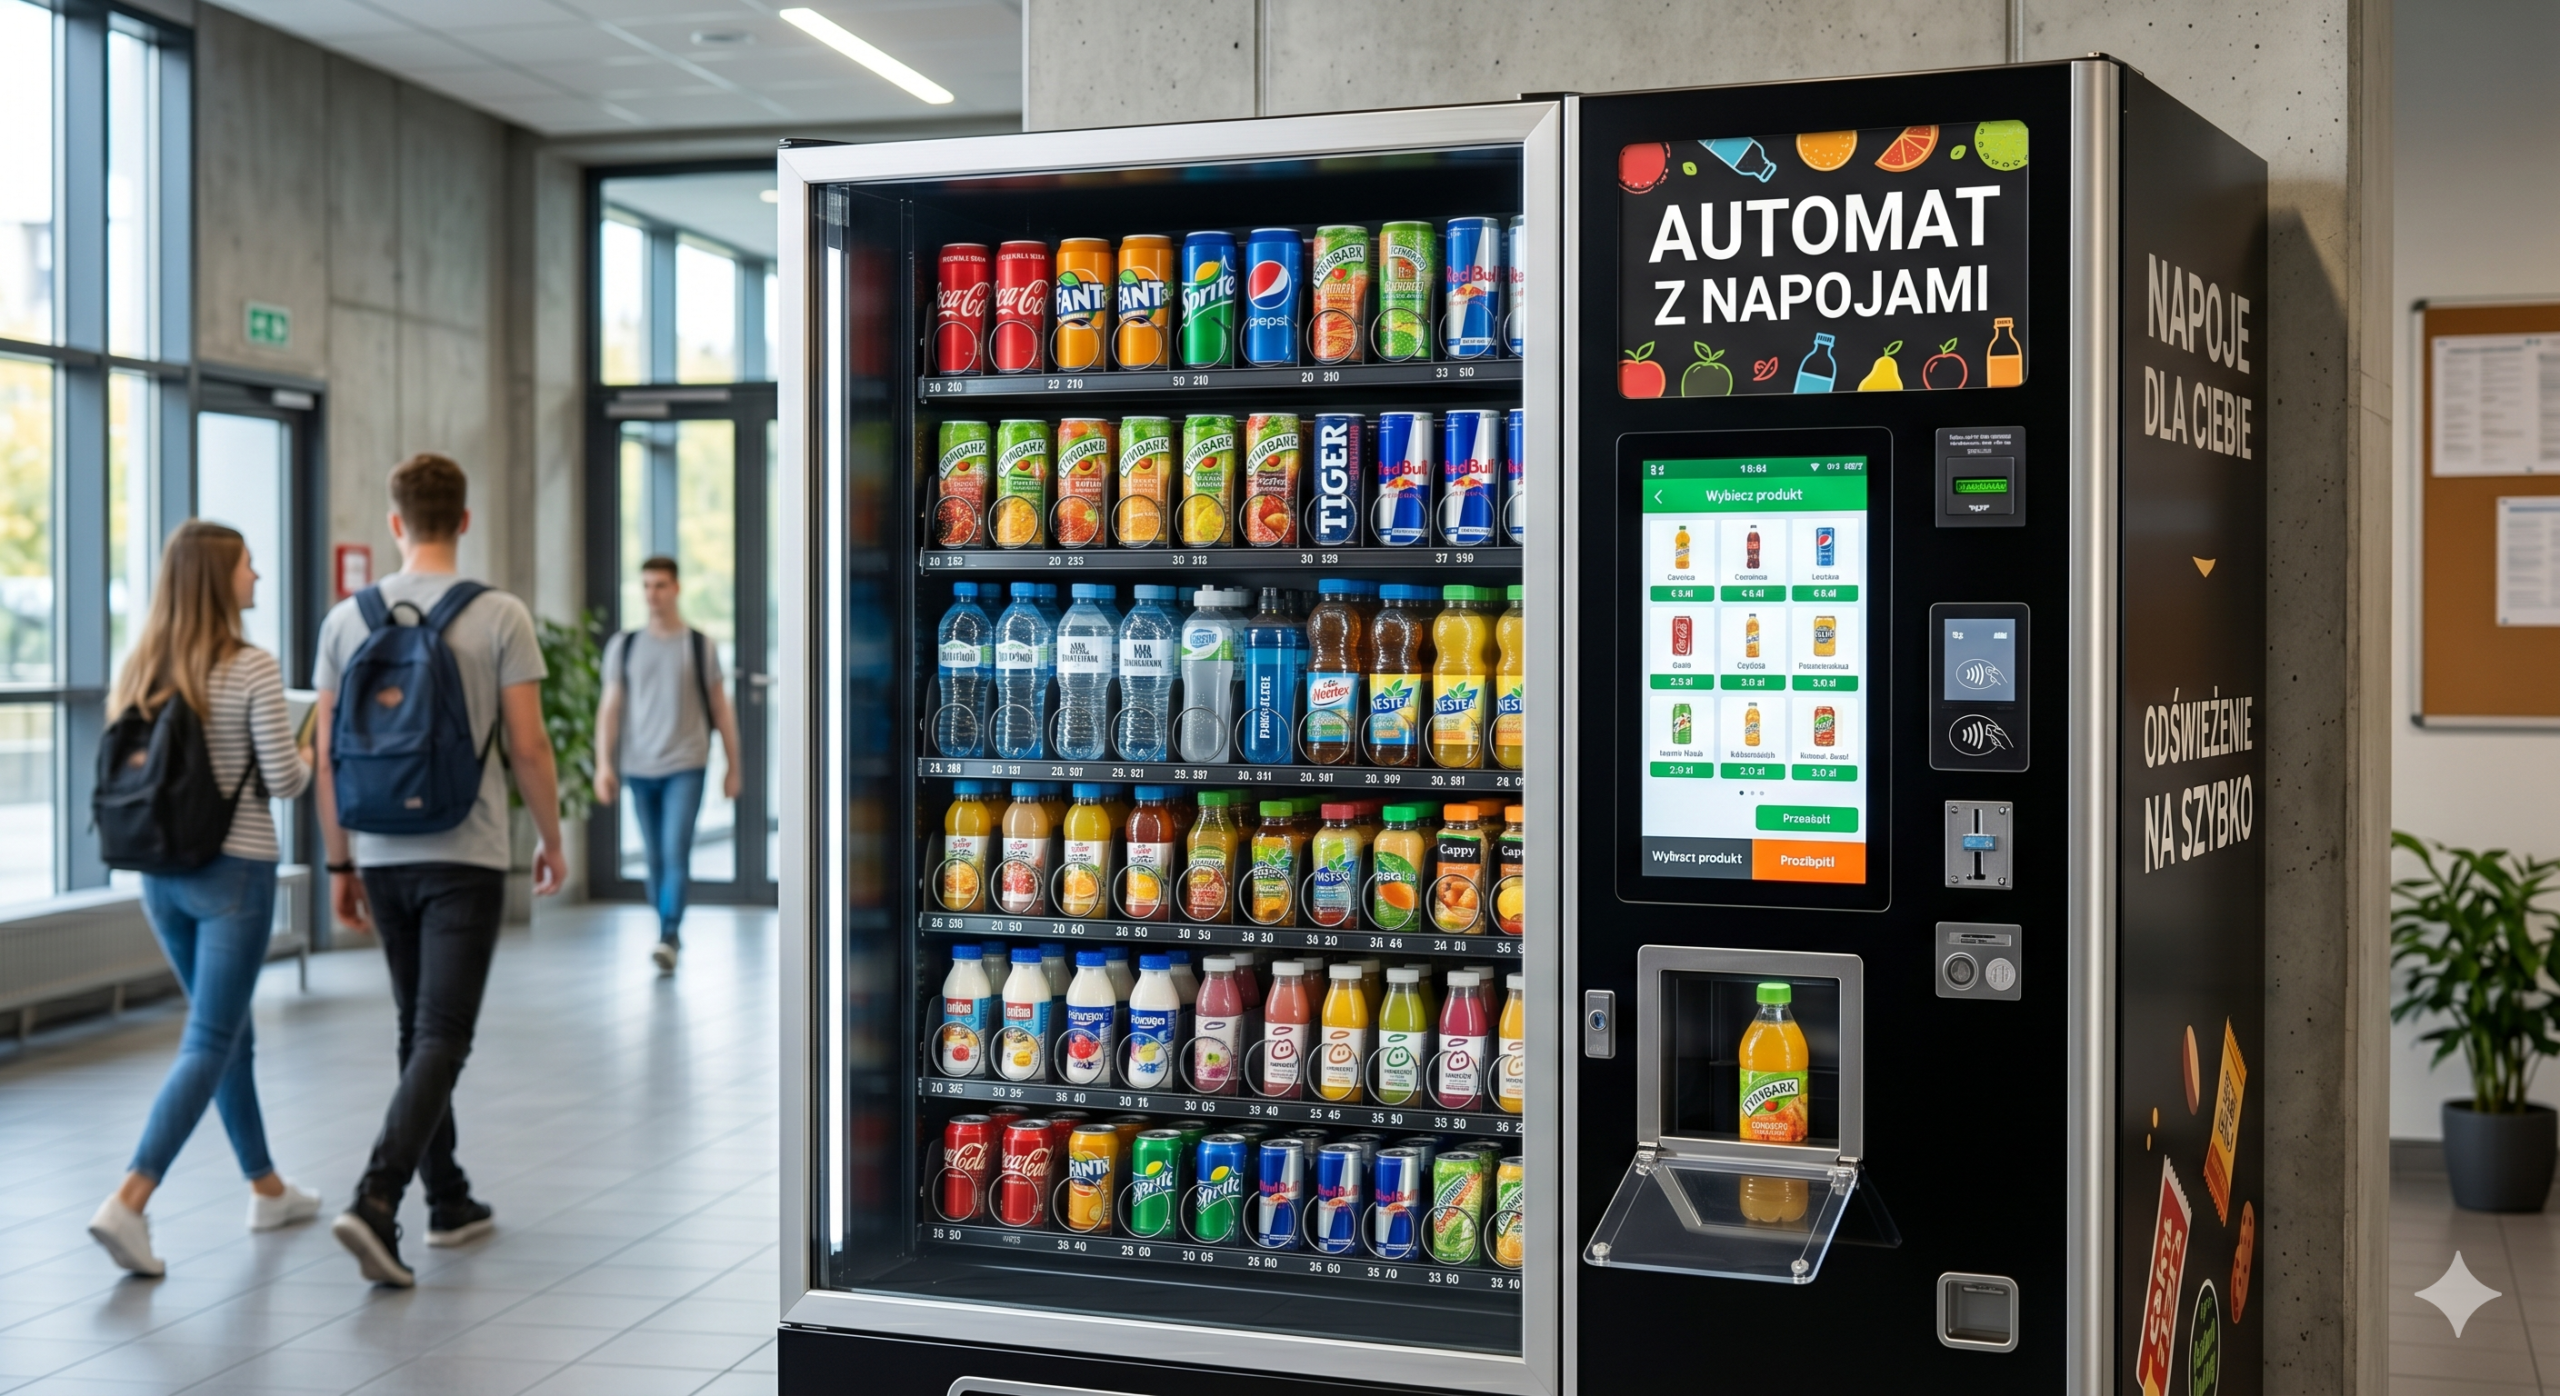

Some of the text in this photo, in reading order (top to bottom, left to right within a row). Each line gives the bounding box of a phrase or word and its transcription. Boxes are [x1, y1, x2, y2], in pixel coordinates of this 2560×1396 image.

[1648, 184, 2001, 264] AUTOMAT
[1182, 274, 1236, 327] Sprite
[1654, 264, 1989, 327] Z NAPOJAMI
[2149, 253, 2250, 375] NAPOJE
[2145, 365, 2252, 460] DLA CIEBIE
[1320, 422, 1348, 534] TIGER
[1706, 487, 1803, 504] Wybiecz produkt
[1435, 698, 1476, 713] NESTEA
[2144, 685, 2253, 768] ODŚWIEŻENIE
[2145, 774, 2253, 874] NA SZYBKO
[1440, 843, 1476, 858] Cappy
[1698, 852, 1743, 865] produkt
[1325, 936, 1337, 946] 20
[993, 1087, 1005, 1097] 30
[1074, 1093, 1086, 1103] 40
[1120, 1097, 1131, 1106] 30
[1185, 1101, 1196, 1111] 30
[1266, 1106, 1278, 1116] 40
[1453, 1119, 1466, 1128] 30
[1328, 1264, 1340, 1273] 60
[1447, 1274, 1459, 1284] 60
